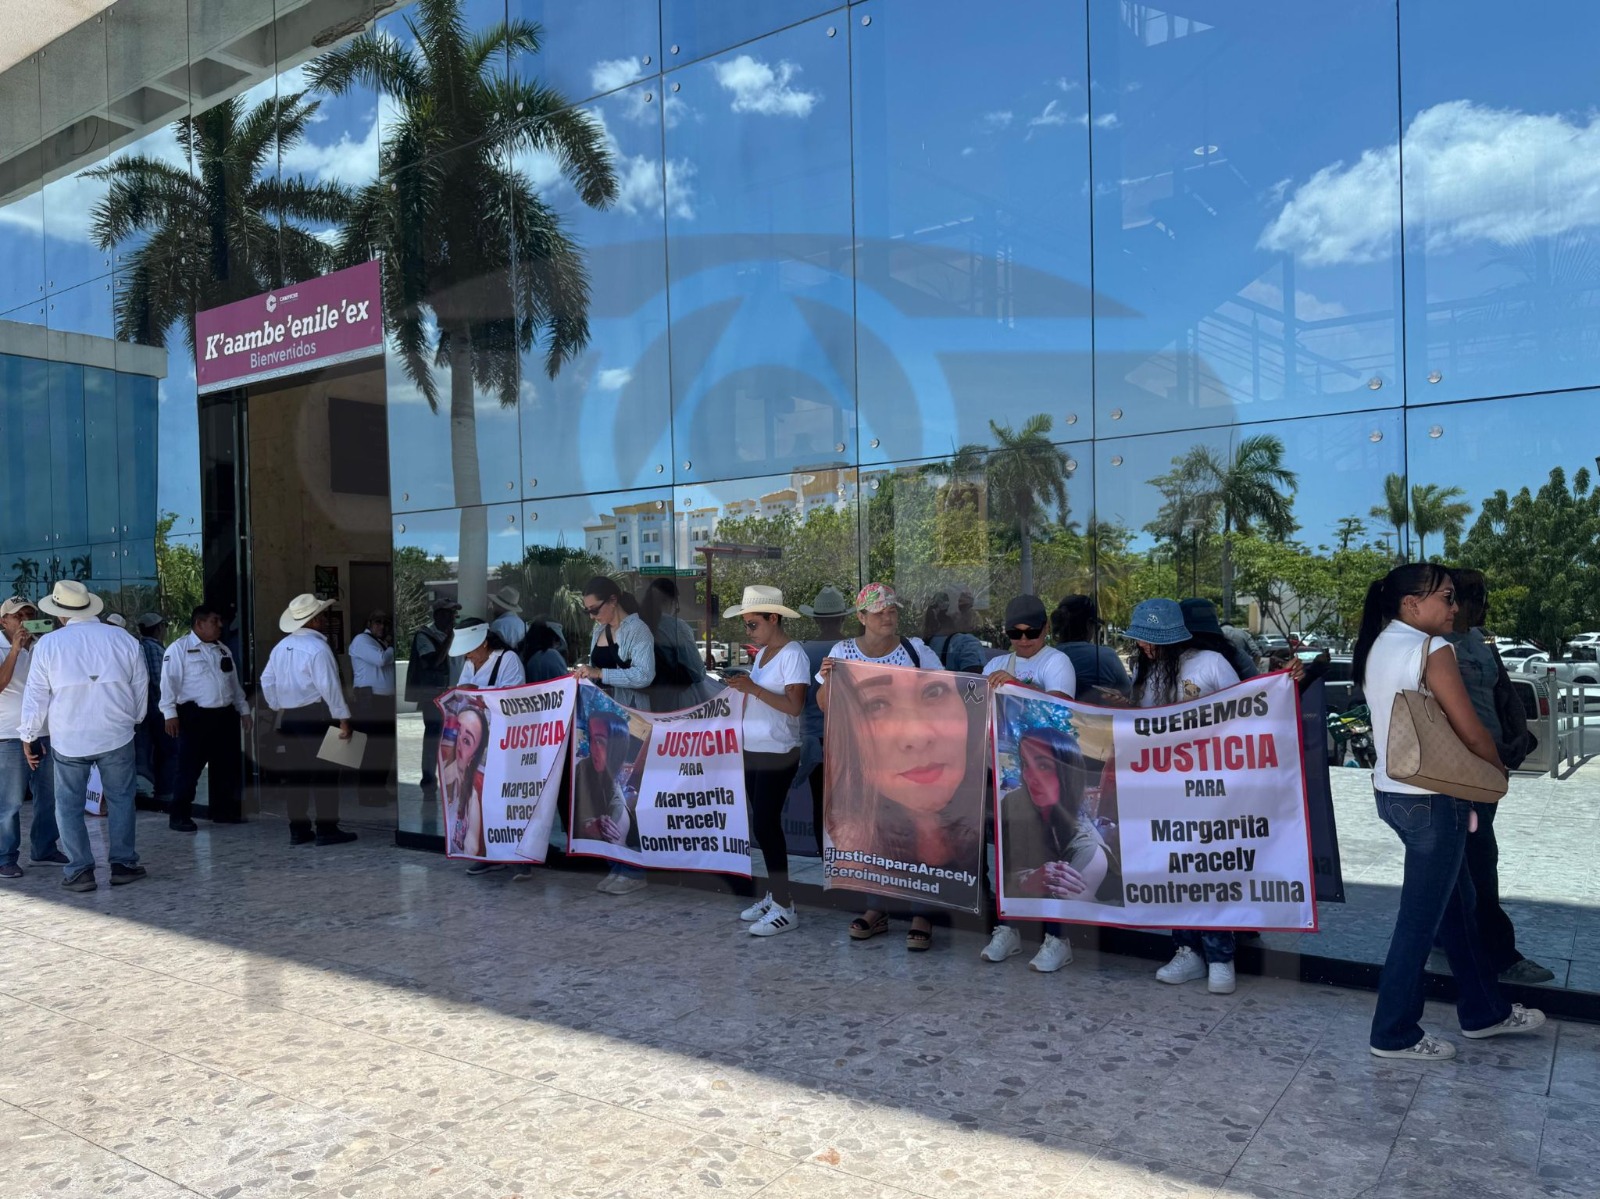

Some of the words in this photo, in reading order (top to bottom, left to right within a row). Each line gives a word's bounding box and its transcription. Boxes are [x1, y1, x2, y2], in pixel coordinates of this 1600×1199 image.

[251, 341, 316, 369] Bienvenidos
[500, 690, 564, 716] QUEREMOS
[1134, 691, 1269, 736] QUEREMOS
[500, 720, 565, 750] JUSTICIA
[657, 728, 739, 757] JUSTICIA
[521, 752, 537, 766] PARA
[1130, 733, 1278, 773] JUSTICIA
[679, 763, 704, 776] PARA
[86, 789, 101, 804] una
[655, 787, 735, 809] Margarita
[1185, 779, 1226, 797] PARA
[507, 805, 536, 821] Arac
[667, 811, 727, 830] Aracely
[1151, 815, 1270, 844] Margarita
[723, 836, 751, 857] Luna
[825, 848, 977, 887] #justiciaparaAracely
[1169, 847, 1256, 874] Aracely
[825, 864, 940, 895] #ceroimpunidad
[1250, 879, 1305, 903] Luna
